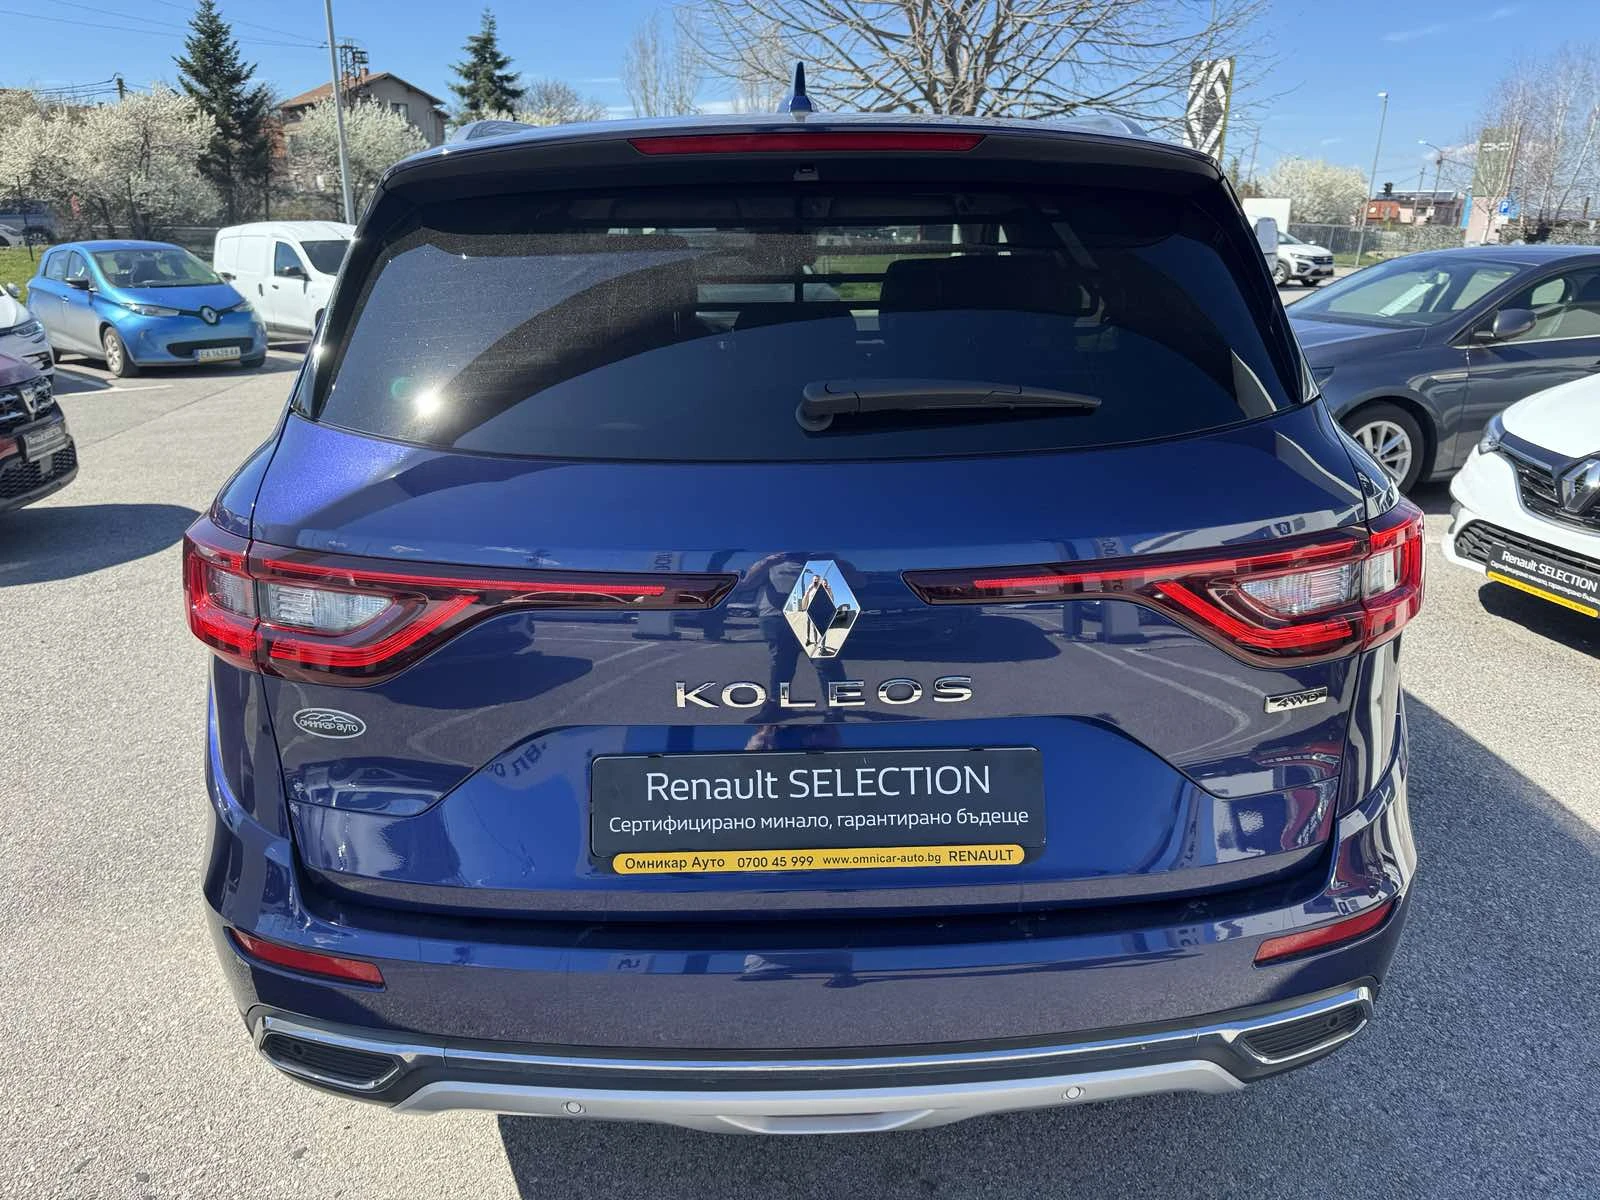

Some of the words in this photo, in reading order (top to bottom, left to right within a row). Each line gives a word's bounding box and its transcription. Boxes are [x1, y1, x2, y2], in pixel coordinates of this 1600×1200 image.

[1502, 551, 1538, 570] Renault
[1538, 563, 1598, 592] SELECTION
[675, 676, 973, 709] KOLEOS
[1277, 692, 1320, 707] 4WD
[646, 769, 779, 801] Renault
[789, 765, 990, 798] SELECTION
[609, 816, 756, 835] Сертифицирано
[761, 816, 833, 830] минало,
[837, 812, 951, 830] гарантирано
[956, 808, 1029, 826] бъдеще
[625, 857, 687, 870] Омникар
[691, 856, 725, 870] Ауто
[737, 857, 768, 868] 0700
[772, 857, 787, 867] 45
[791, 856, 814, 867] 999
[822, 853, 941, 864] www.omnicar-auto.bg
[948, 850, 1014, 862] RENAULT
